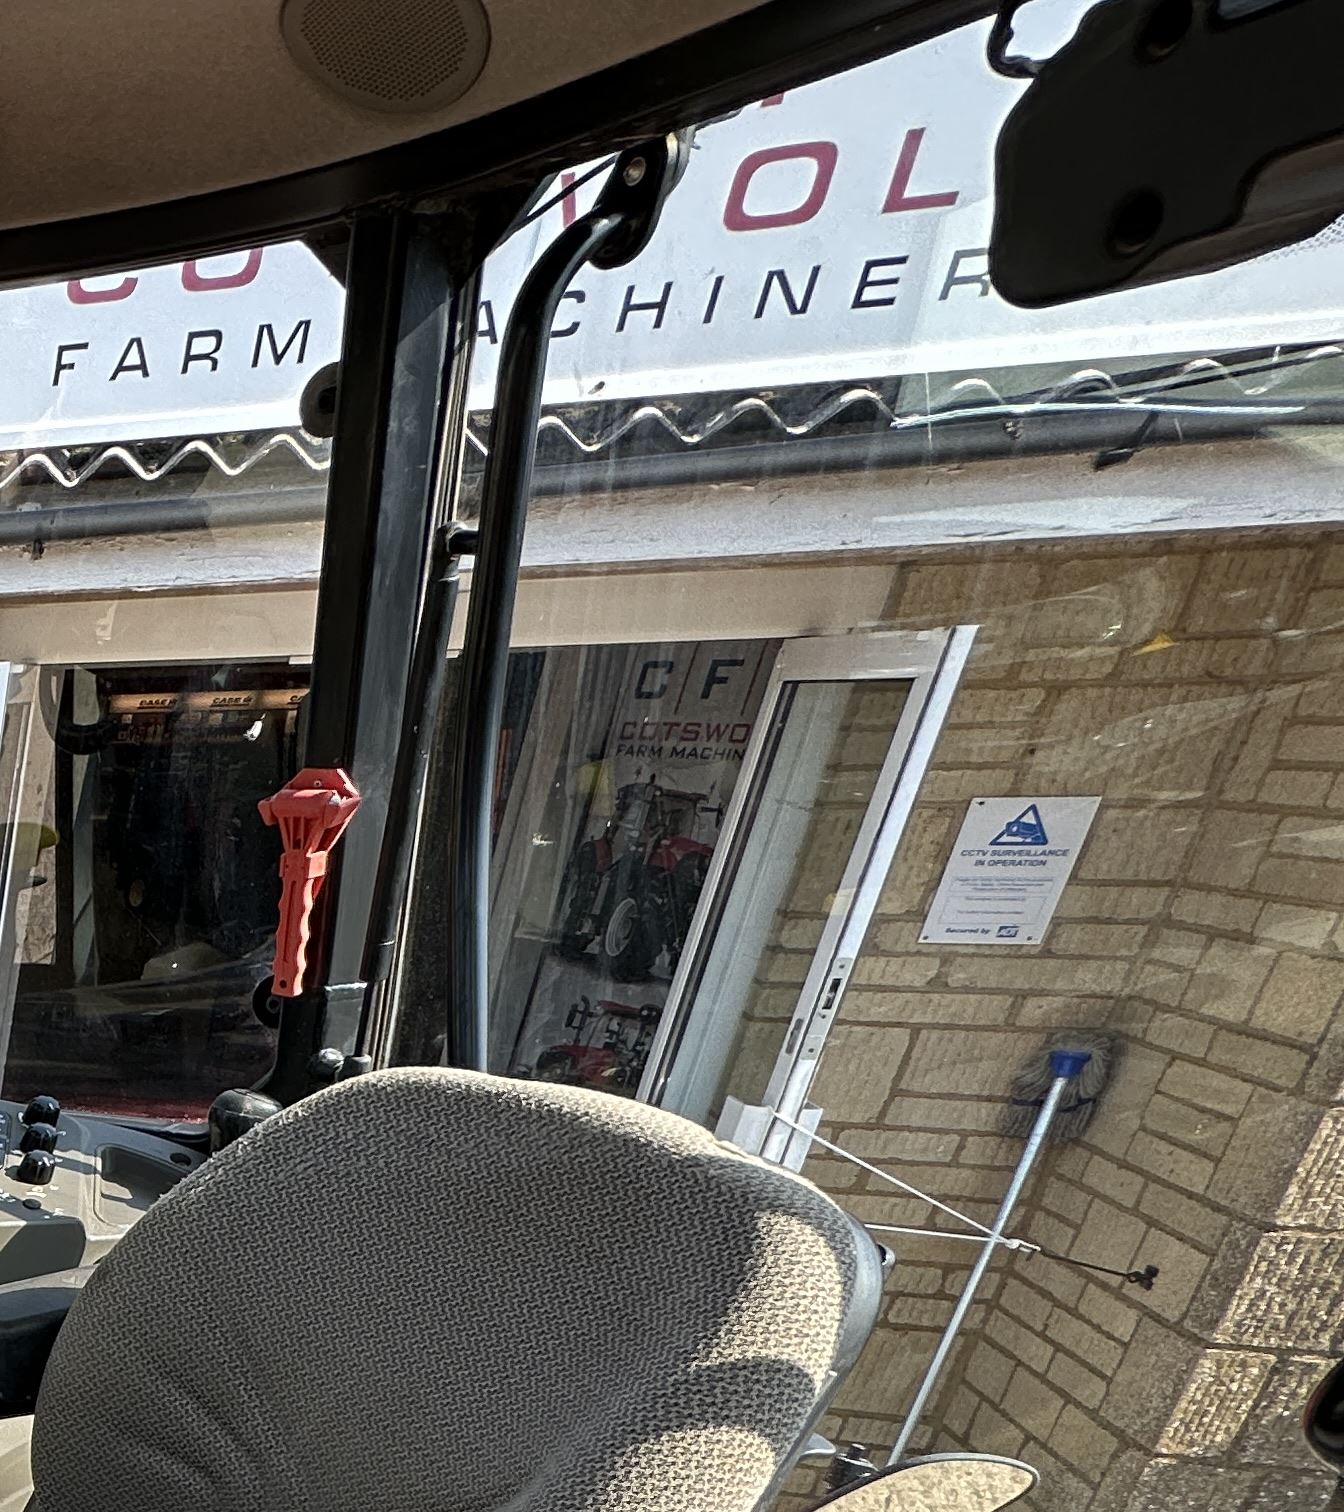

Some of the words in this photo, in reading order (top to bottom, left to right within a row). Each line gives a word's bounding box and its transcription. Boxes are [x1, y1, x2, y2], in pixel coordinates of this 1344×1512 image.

[52, 319, 311, 387] FARM
[619, 721, 752, 744] COTSWO
[616, 743, 663, 759] FARM
[670, 744, 744, 761] MACHIN
[960, 849, 988, 857] CCTV
[990, 849, 1070, 857] SURVEILLANCE
[974, 859, 986, 867] IN
[987, 859, 1047, 867] OPERATION
